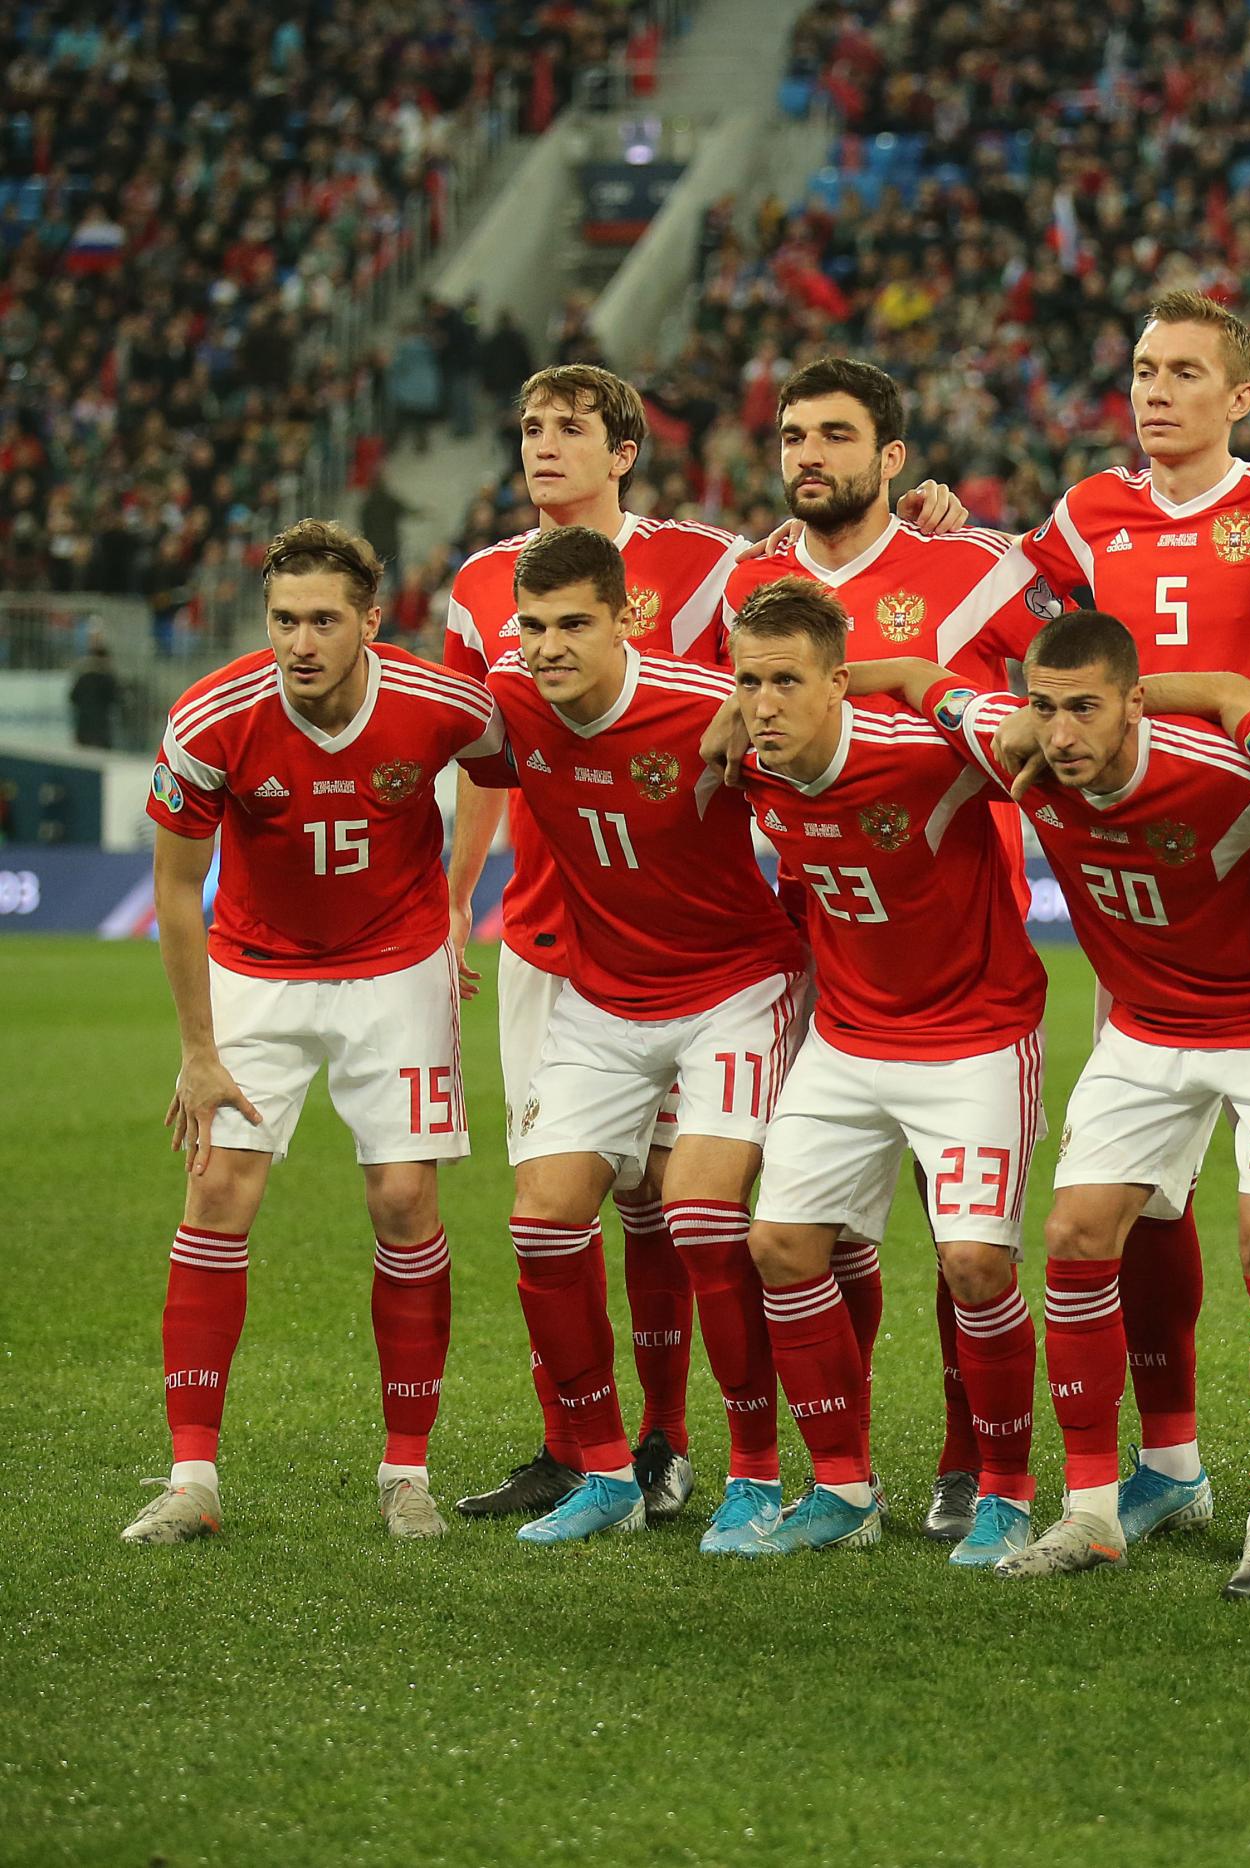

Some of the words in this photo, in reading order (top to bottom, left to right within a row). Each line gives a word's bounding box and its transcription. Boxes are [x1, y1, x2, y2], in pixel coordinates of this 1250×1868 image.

[1156, 577, 1189, 645] 5
[254, 789, 290, 797] adidas
[1035, 811, 1064, 829] adidas
[303, 819, 369, 875] 15
[577, 807, 638, 867] 11
[803, 863, 889, 923] 23
[1080, 863, 1169, 927] 20
[399, 1066, 454, 1134] 15
[714, 1051, 763, 1119] 11
[935, 1146, 1010, 1218] 23
[973, 1412, 1031, 1437] РОССИЯ
